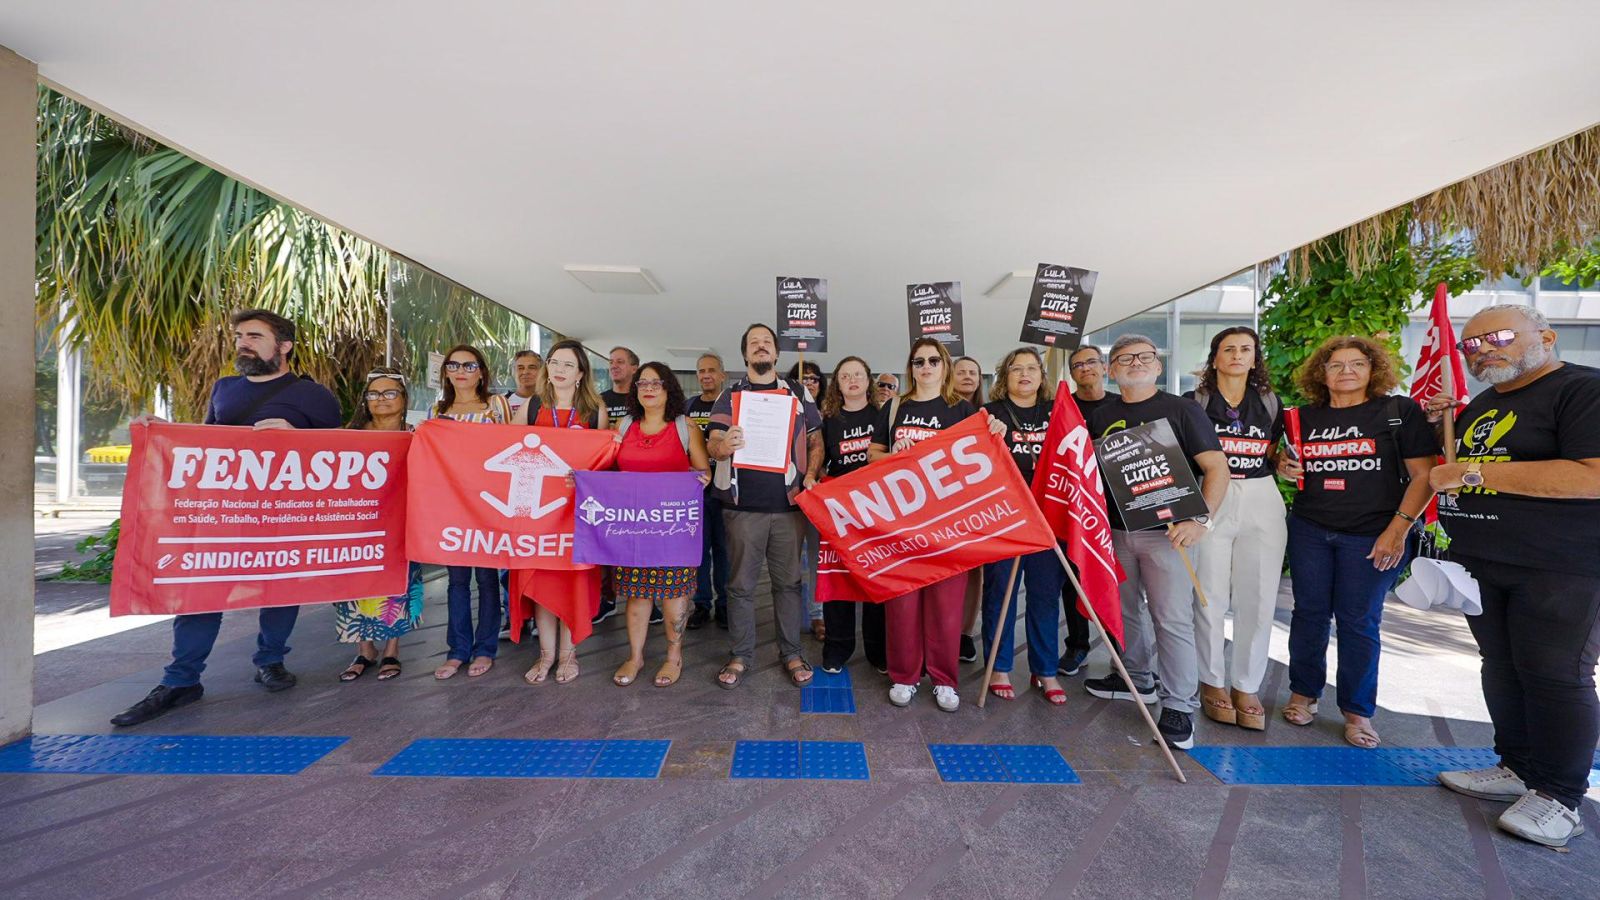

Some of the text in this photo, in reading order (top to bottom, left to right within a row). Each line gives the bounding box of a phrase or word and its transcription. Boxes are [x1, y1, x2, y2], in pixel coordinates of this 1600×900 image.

[1043, 292, 1070, 301] JORNADA
[786, 308, 818, 320] LUTAS
[787, 302, 810, 310] JORNADA
[919, 308, 943, 316] JORNADA
[1040, 298, 1078, 314] LUTAS
[919, 313, 952, 326] LUTAS
[903, 413, 941, 429] LULA,
[1308, 425, 1364, 441] LULA,
[1302, 441, 1374, 457] CUMPRA
[167, 446, 390, 491] FENASPS
[1120, 453, 1166, 473] JORNADA DE
[1306, 457, 1382, 473] ACORDO!
[1124, 462, 1171, 486] LUTAS
[1149, 476, 1173, 488] MARÇO
[823, 434, 994, 538] ANDES
[174, 498, 379, 510] Federação Nacional de Sindicatos de Trabalhadores
[173, 511, 379, 525] em Saúde, Trabalho, Previdência e Assistência Social
[604, 506, 700, 523] SINASEFE
[855, 499, 1020, 569] SINDICATO NACIONAL
[181, 548, 300, 570] SINDICATOS
[306, 543, 385, 565] FILIADOS
